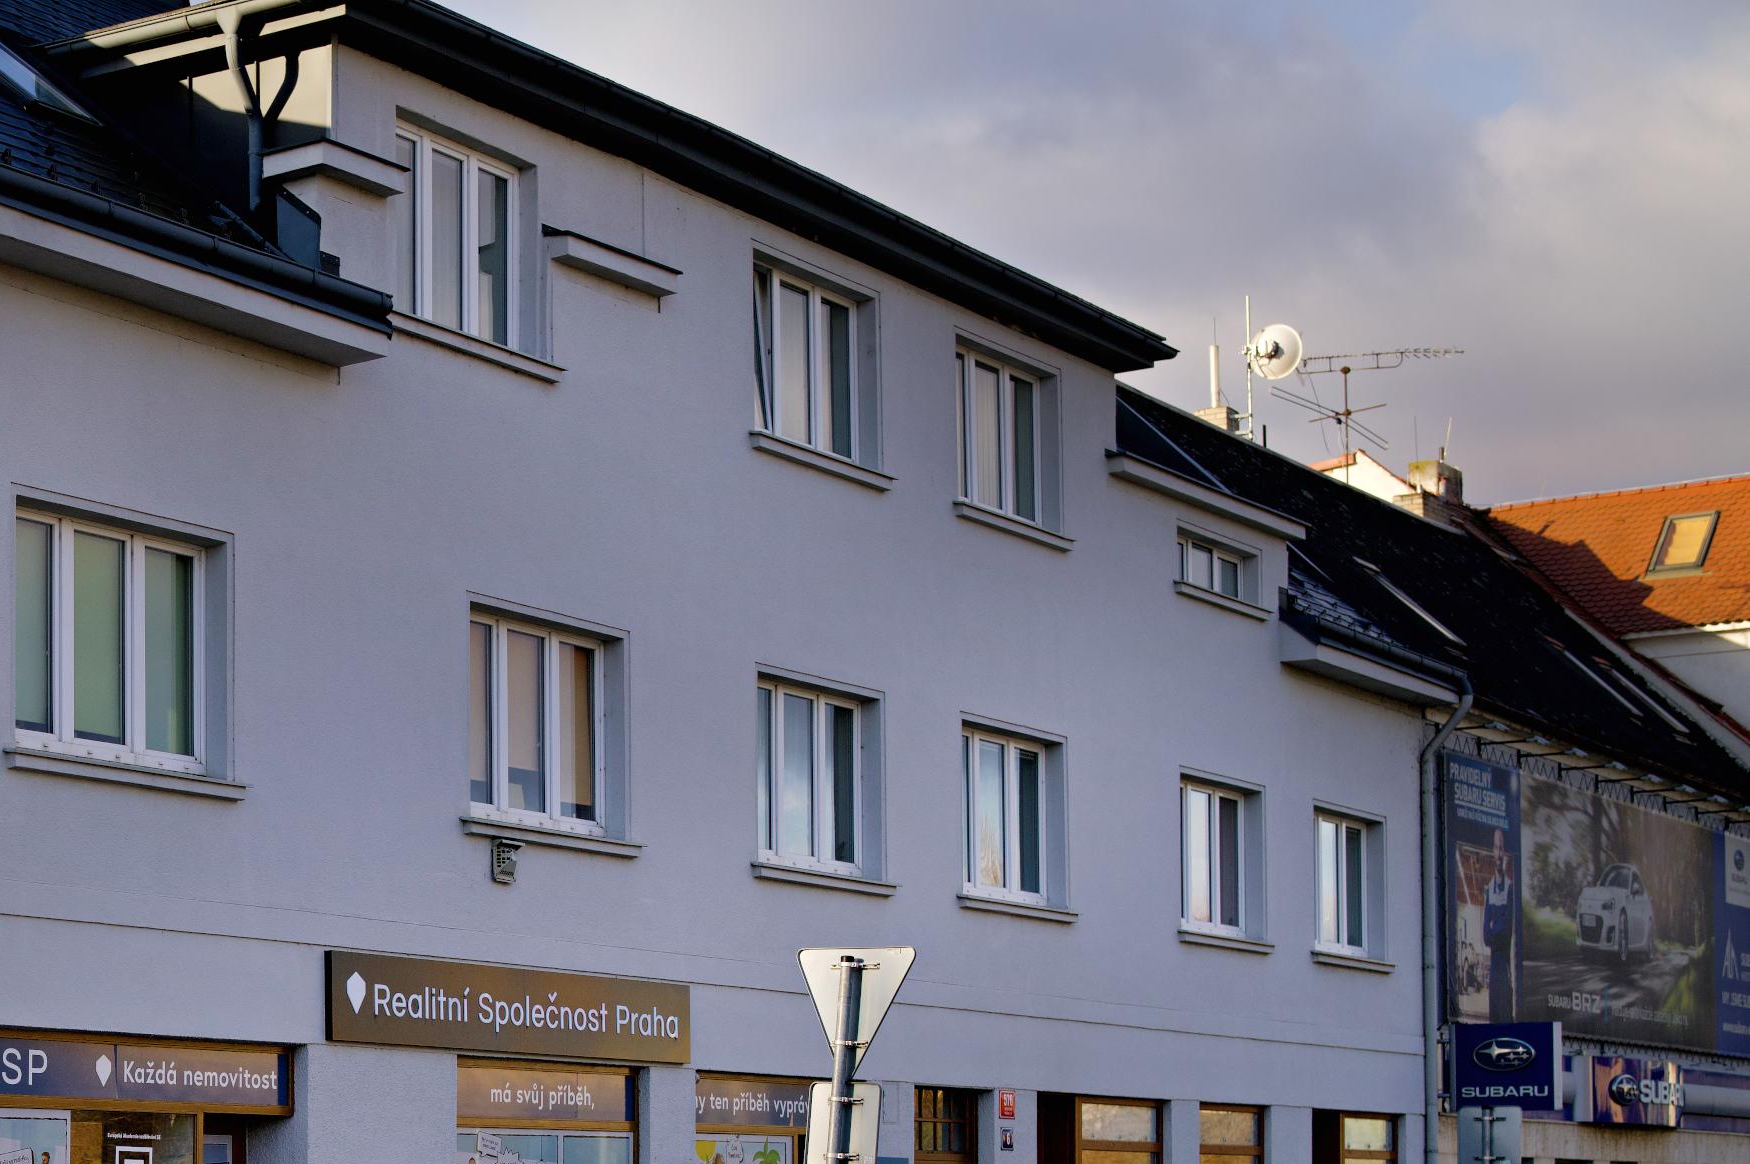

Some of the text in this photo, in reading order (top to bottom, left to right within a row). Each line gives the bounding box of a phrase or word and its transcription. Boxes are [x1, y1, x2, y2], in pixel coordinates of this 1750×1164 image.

[1454, 782, 1506, 811] SUBARU SERVIS
[373, 983, 679, 1039] Realitní Společnost Praha
[1547, 991, 1601, 1014] SUBARU BRZ
[123, 1060, 278, 1090] Každá nemovitost
[490, 1084, 595, 1110] má svůj příběh,
[710, 1093, 729, 1109] ten
[733, 1092, 770, 1116] příběh
[1461, 1085, 1549, 1098] SUBARU
